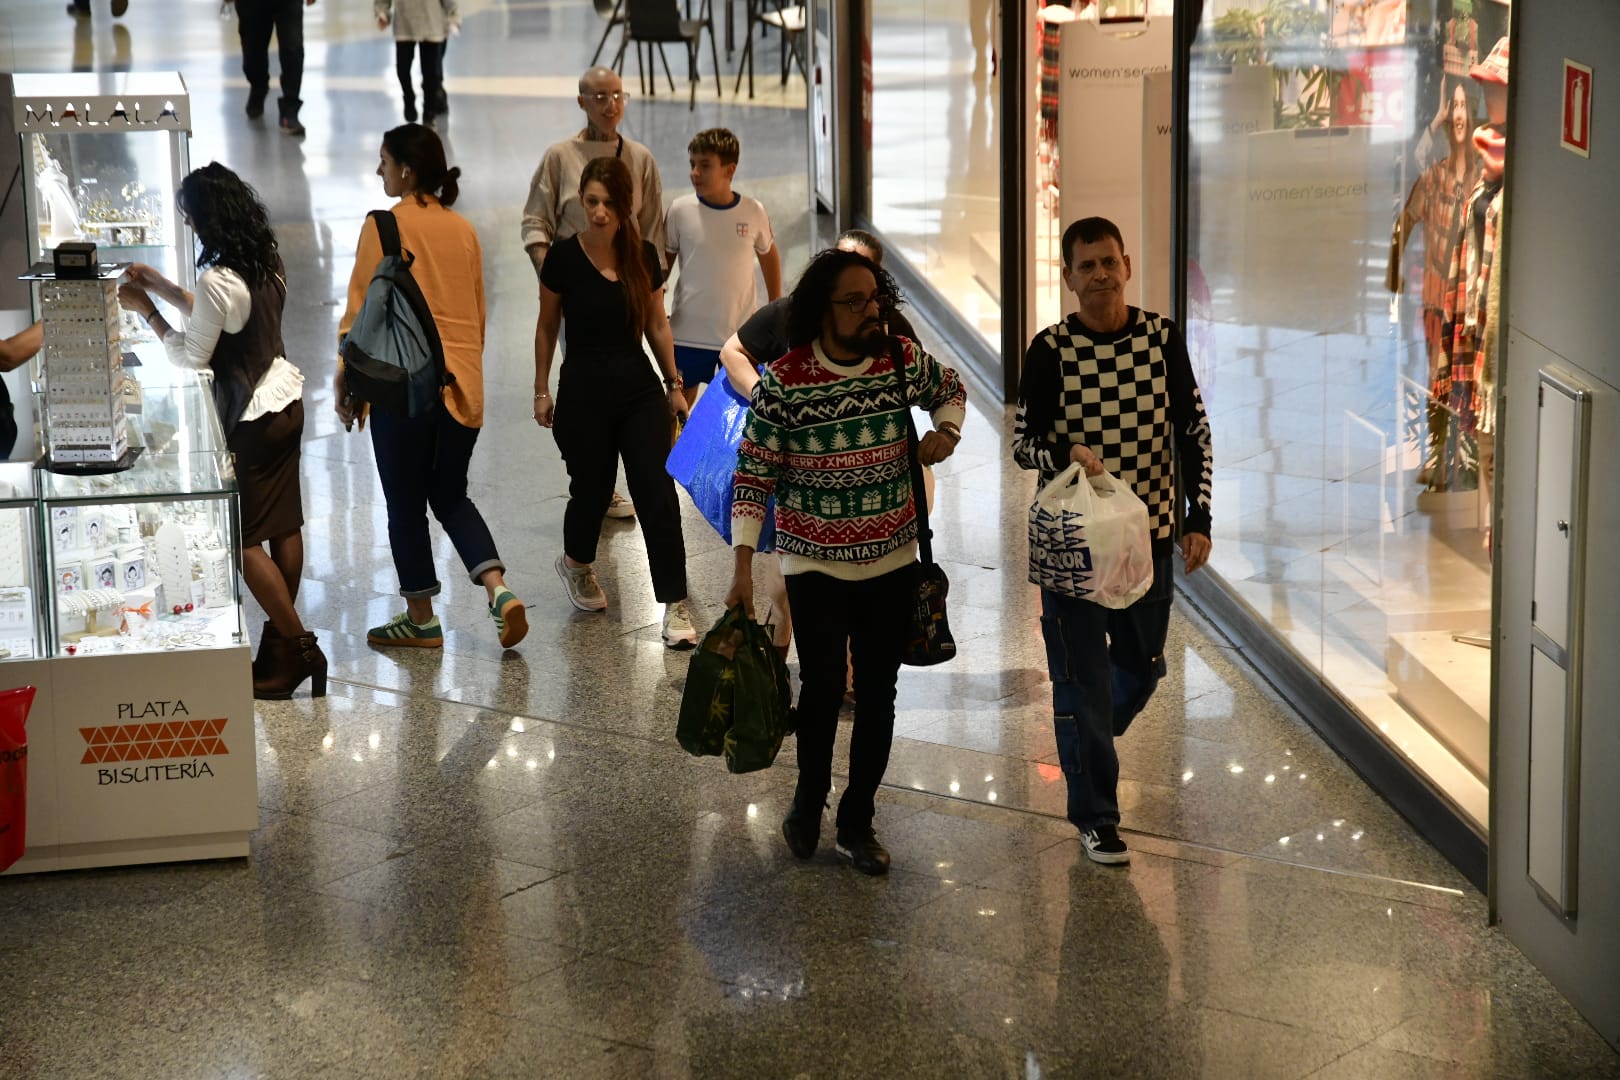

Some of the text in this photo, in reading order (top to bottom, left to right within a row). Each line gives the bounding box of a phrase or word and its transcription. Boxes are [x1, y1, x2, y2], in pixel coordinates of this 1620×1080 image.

[24, 101, 181, 127] MALALA
[1251, 183, 1368, 201] women'secret
[826, 453, 864, 468] XMAS
[826, 536, 899, 560] SANTA'S FAN
[118, 700, 189, 719] PLATA
[98, 759, 215, 785] BISUTERÍA
